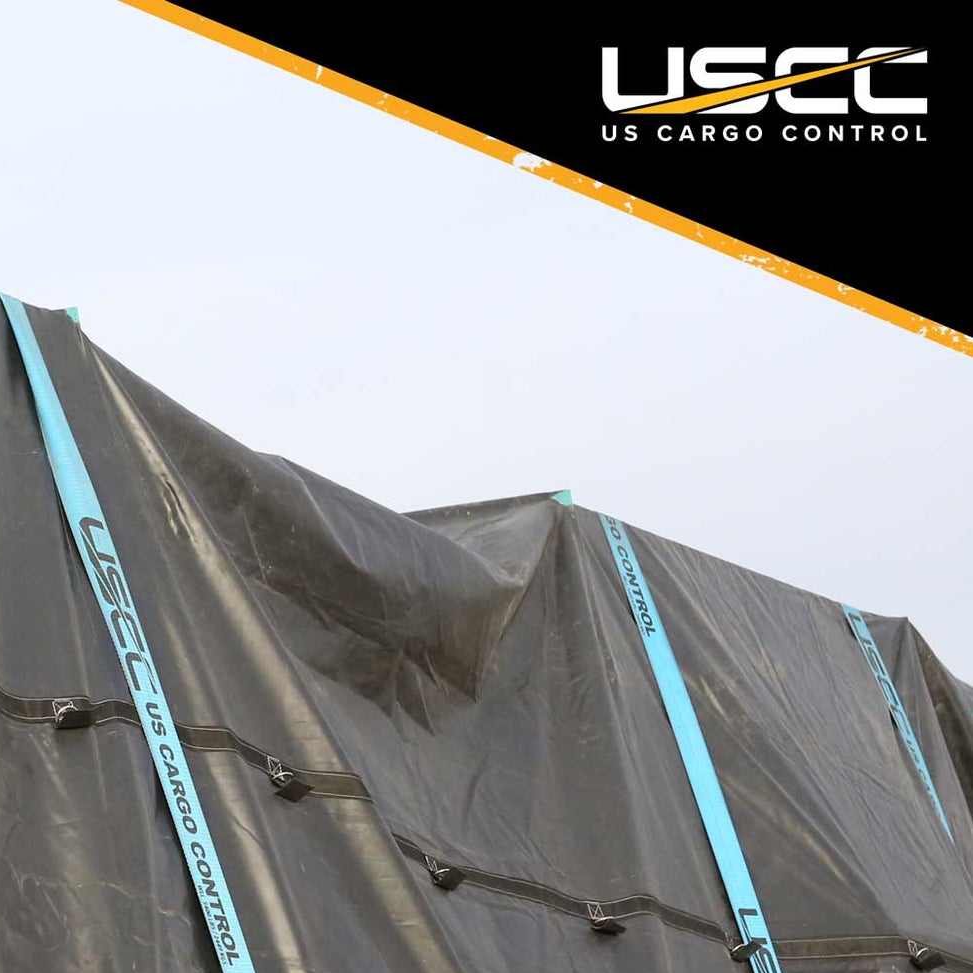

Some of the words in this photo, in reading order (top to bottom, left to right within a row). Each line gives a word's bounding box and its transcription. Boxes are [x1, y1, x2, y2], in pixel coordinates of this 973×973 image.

[617, 545, 656, 637] CONTROL
[78, 516, 157, 695] USCC
[145, 701, 167, 738] US
[159, 743, 199, 835] CARGO
[190, 841, 240, 966] CONTROL
